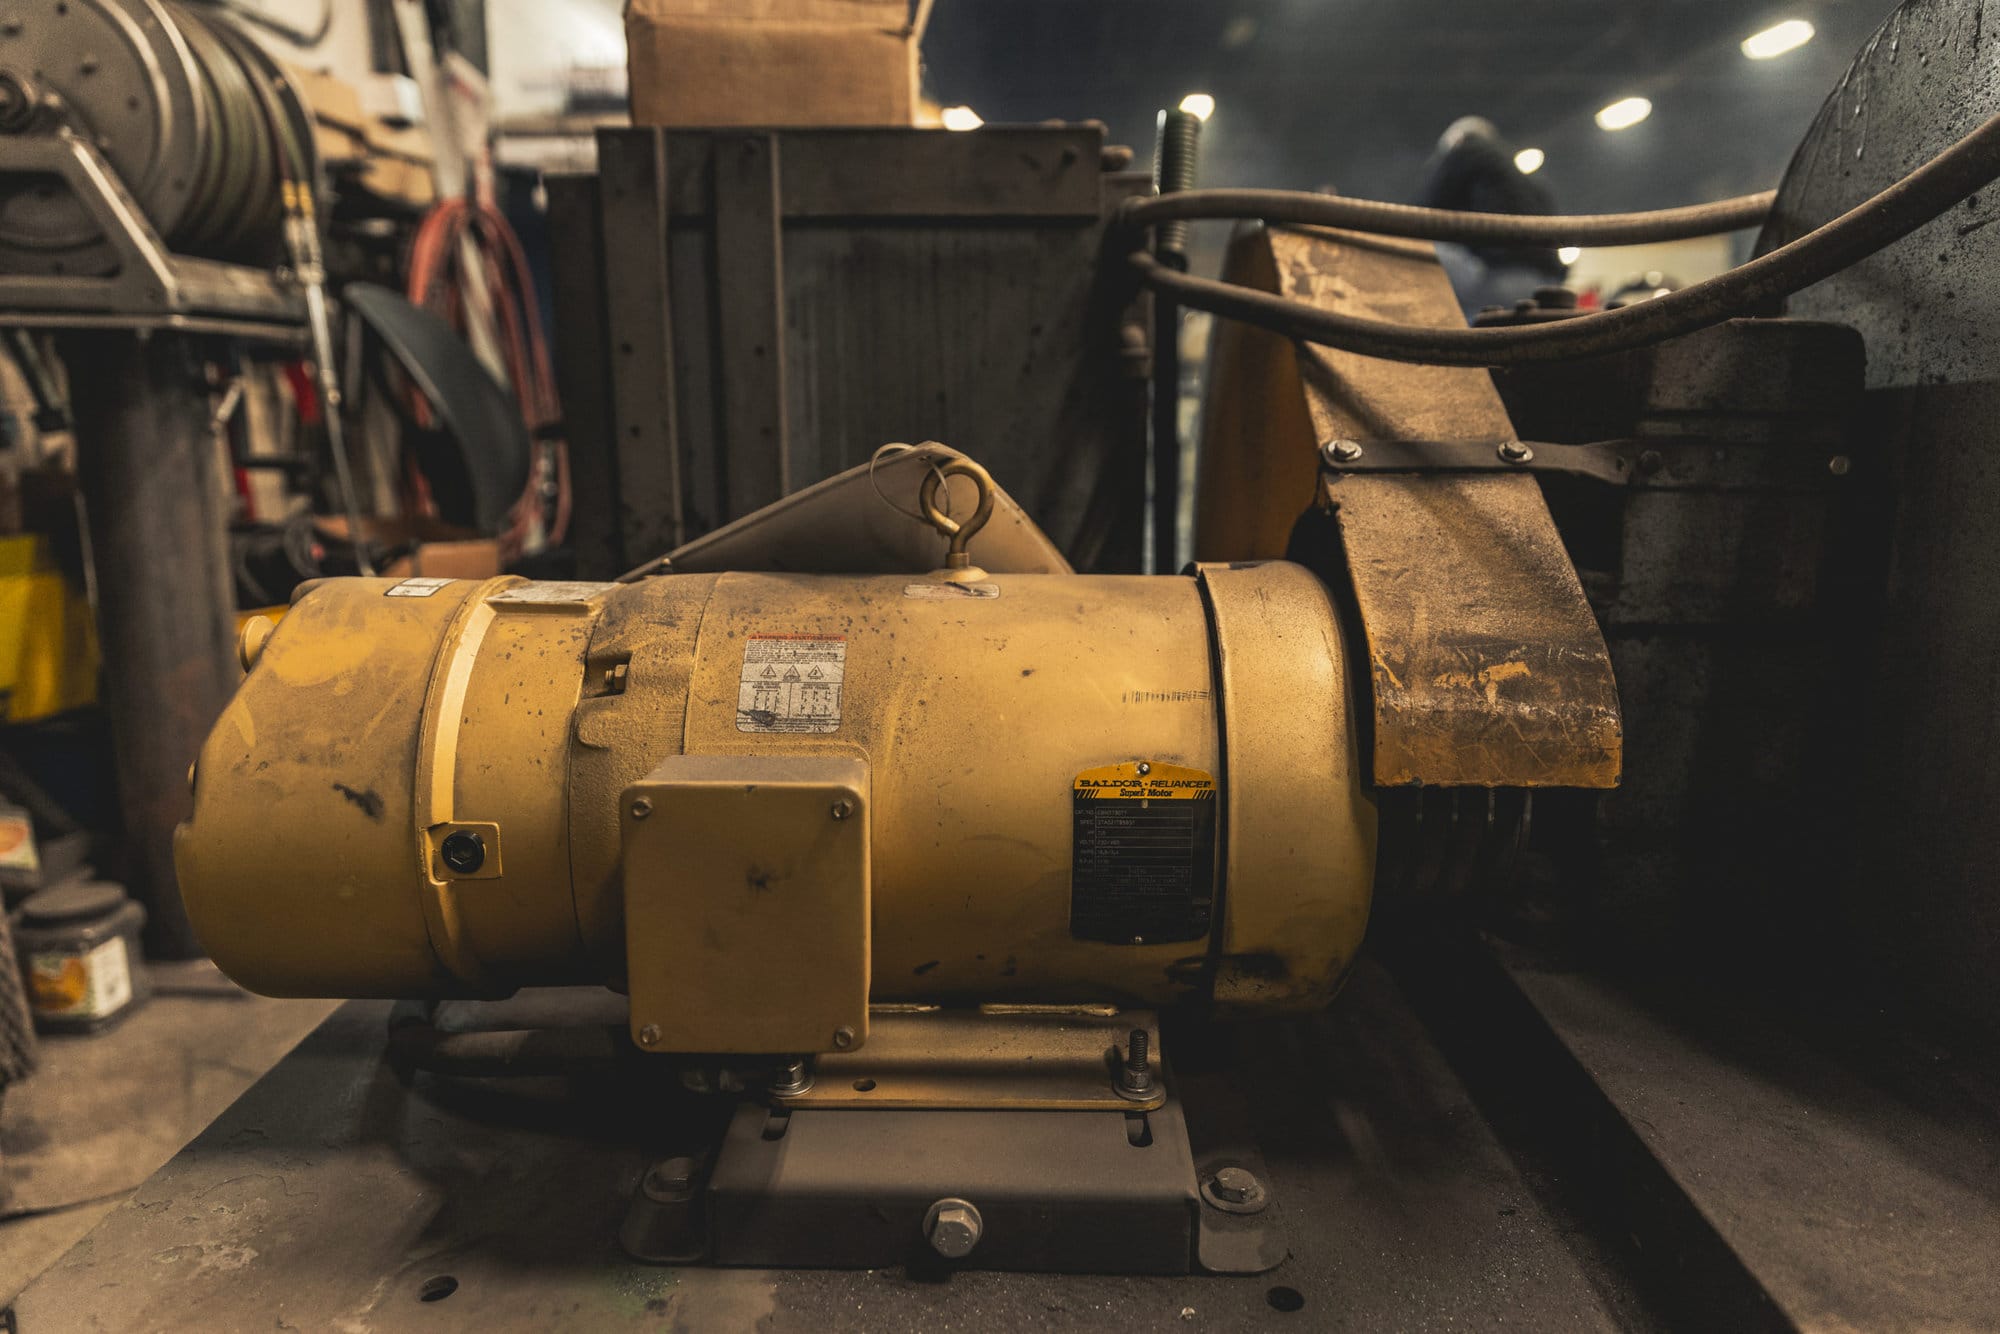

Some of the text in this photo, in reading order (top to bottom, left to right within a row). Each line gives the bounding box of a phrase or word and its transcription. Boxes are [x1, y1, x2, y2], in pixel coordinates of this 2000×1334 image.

[1150, 780, 1203, 788] RELIANCE
[1120, 788, 1173, 798] SuperE Motor
